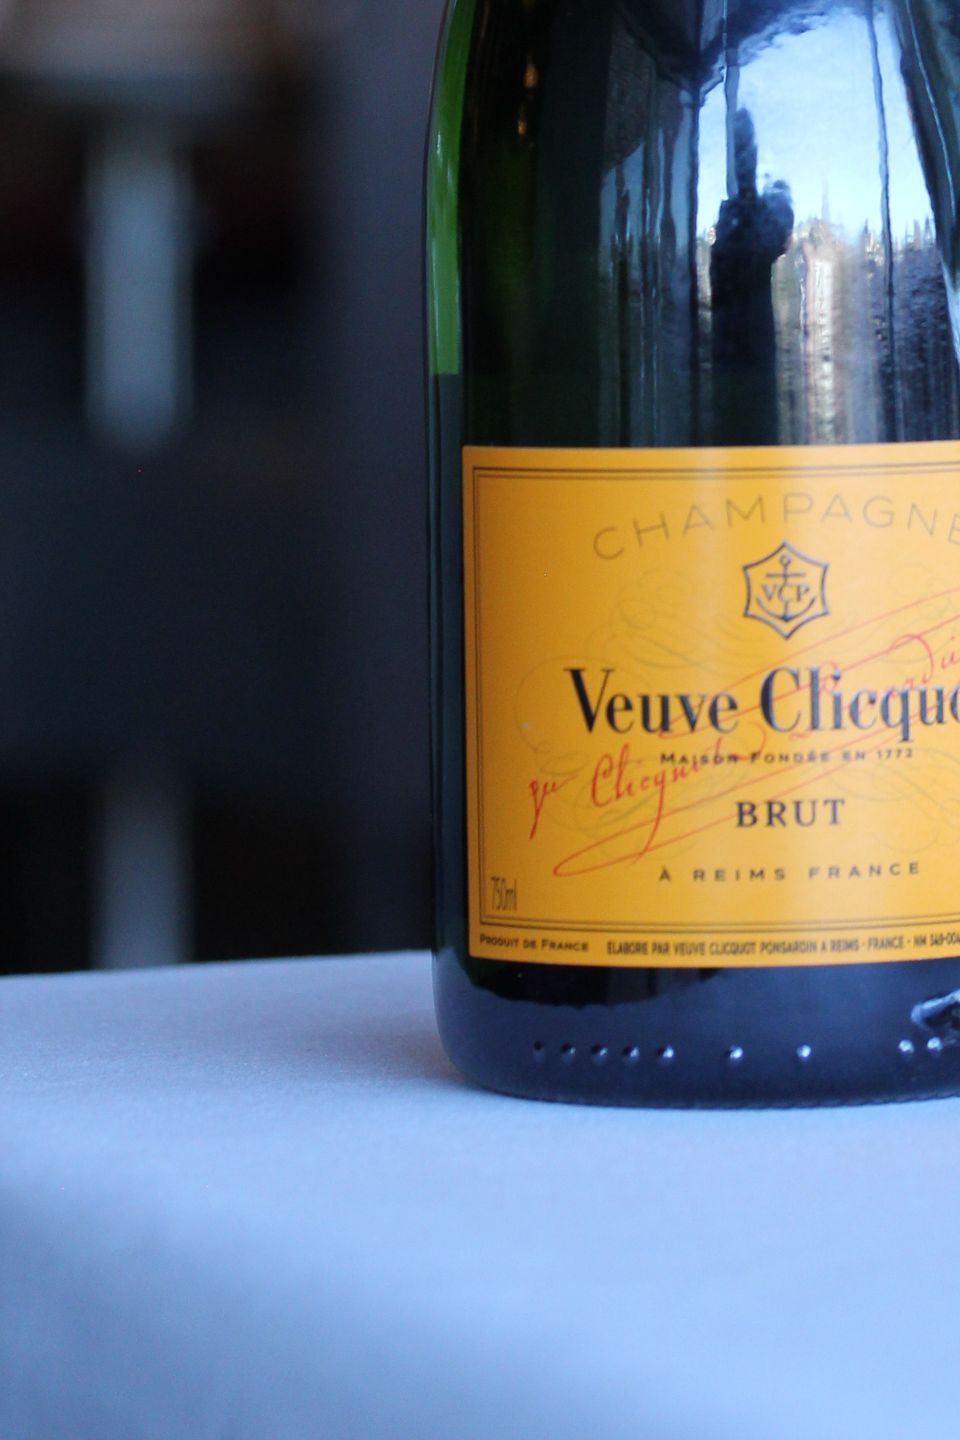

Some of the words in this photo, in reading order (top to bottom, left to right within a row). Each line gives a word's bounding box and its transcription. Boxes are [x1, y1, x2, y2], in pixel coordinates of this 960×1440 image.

[761, 582, 810, 602] VCP
[563, 667, 741, 735] Veuve
[877, 747, 914, 760] 1772
[735, 798, 846, 829] BRUT
[693, 866, 787, 882] REIMS
[808, 861, 921, 879] FRANCE
[541, 939, 589, 952] FRANCE
[651, 942, 670, 955] PAR
[674, 941, 705, 956] VEUVE
[709, 941, 757, 955] CLICQUOT
[867, 936, 905, 950] FRANCE
